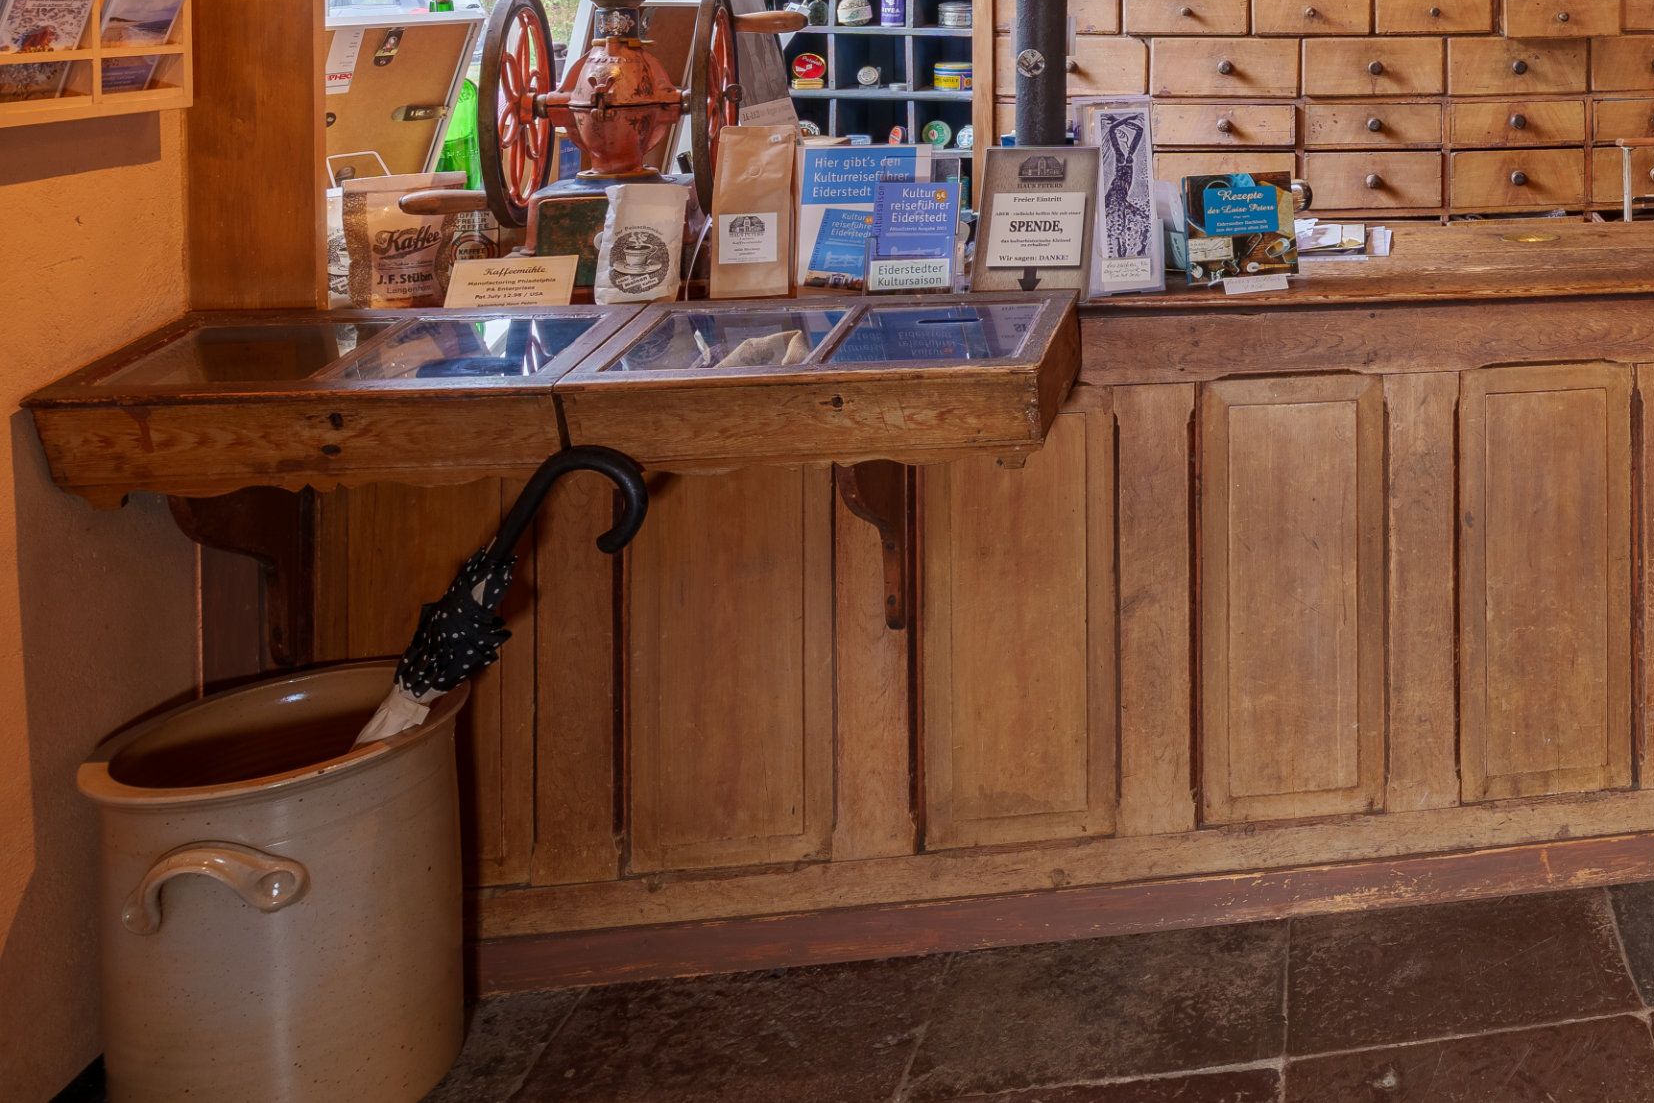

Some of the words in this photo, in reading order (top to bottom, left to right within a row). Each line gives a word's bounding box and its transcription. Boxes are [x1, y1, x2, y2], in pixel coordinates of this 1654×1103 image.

[815, 157, 838, 168] Hier
[843, 156, 876, 169] gibt's
[880, 155, 900, 166] den
[813, 171, 910, 183] Kulturreiseführer
[812, 186, 872, 197] Eiderstedt
[902, 188, 937, 198] Kultur
[1217, 190, 1264, 201] Rezepte
[890, 201, 950, 211] reiseführer
[1207, 206, 1220, 214] der
[1248, 203, 1275, 214] Peters
[841, 212, 866, 220] Kultur
[891, 212, 948, 223] Eiderstedt
[1009, 220, 1064, 233] SPENDE,
[373, 225, 442, 254] Kaffee
[483, 266, 547, 277] Kaffeemühle
[878, 264, 944, 276] Eiderstedter
[877, 276, 942, 287] Kultursaison
